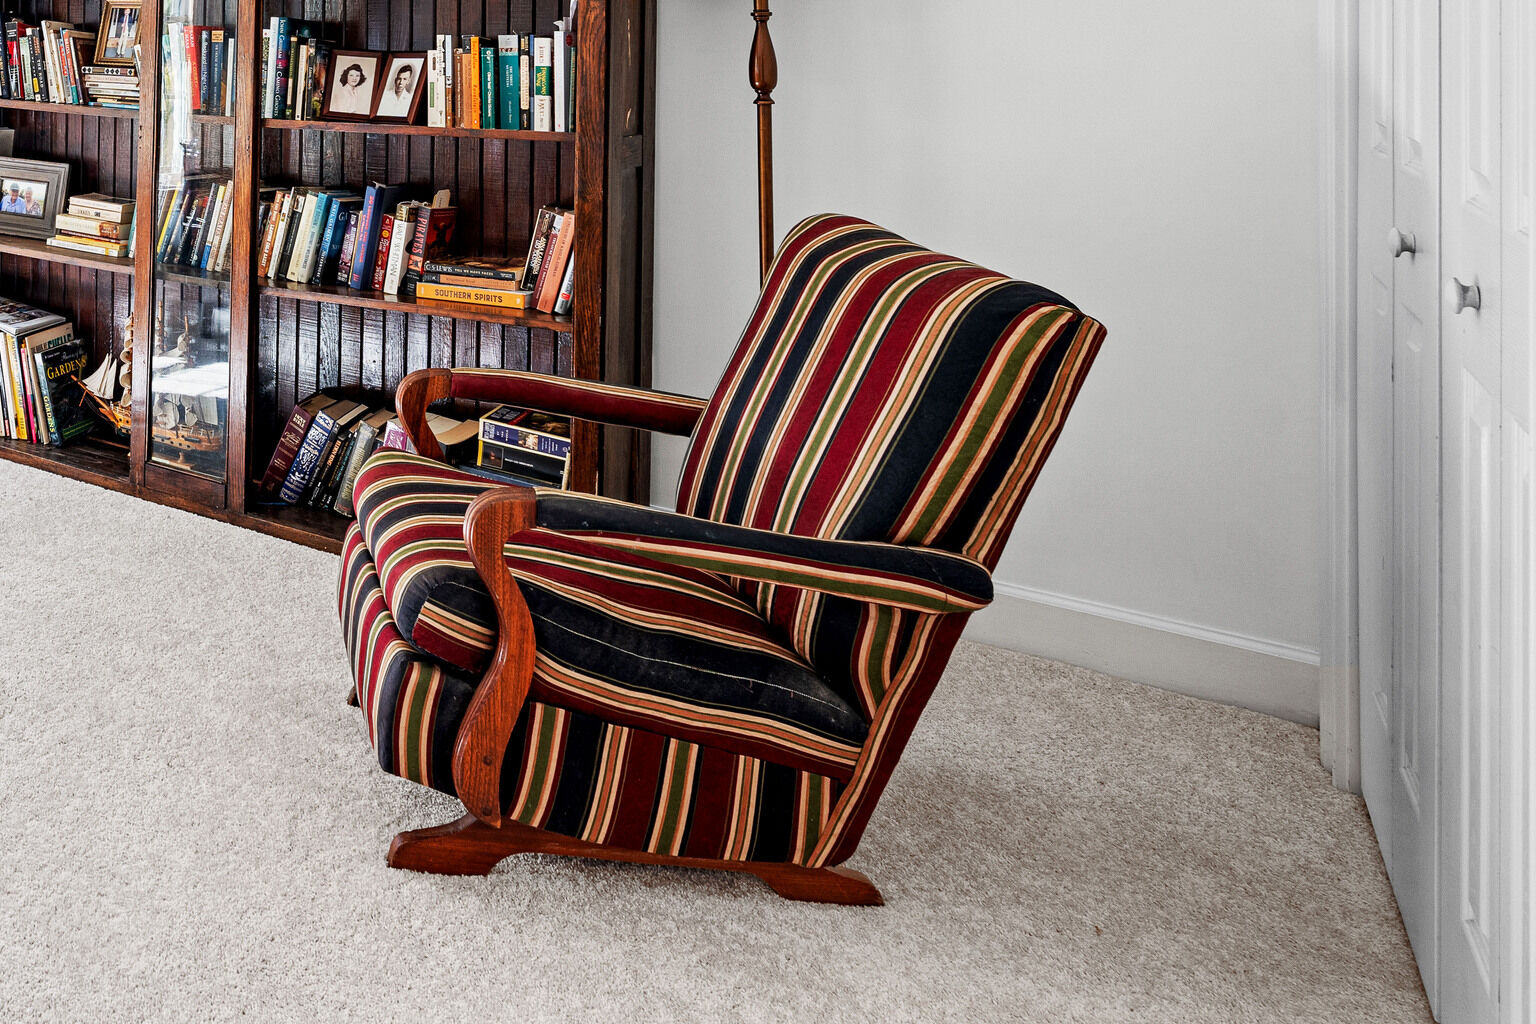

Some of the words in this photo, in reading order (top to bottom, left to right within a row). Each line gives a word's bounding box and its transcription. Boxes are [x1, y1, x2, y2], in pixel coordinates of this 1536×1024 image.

[277, 34, 285, 59] GRISHAM
[274, 71, 282, 94] CAMINO
[273, 94, 281, 117] GHOSTS
[324, 217, 333, 242] GAIMAN
[411, 217, 427, 254] PIRATES
[389, 240, 402, 276] WHITMAN
[434, 288, 472, 300] SOUTHERN
[474, 293, 503, 303] SPIRITS
[47, 355, 88, 380] GARDENS
[43, 396, 55, 433] GARDENS
